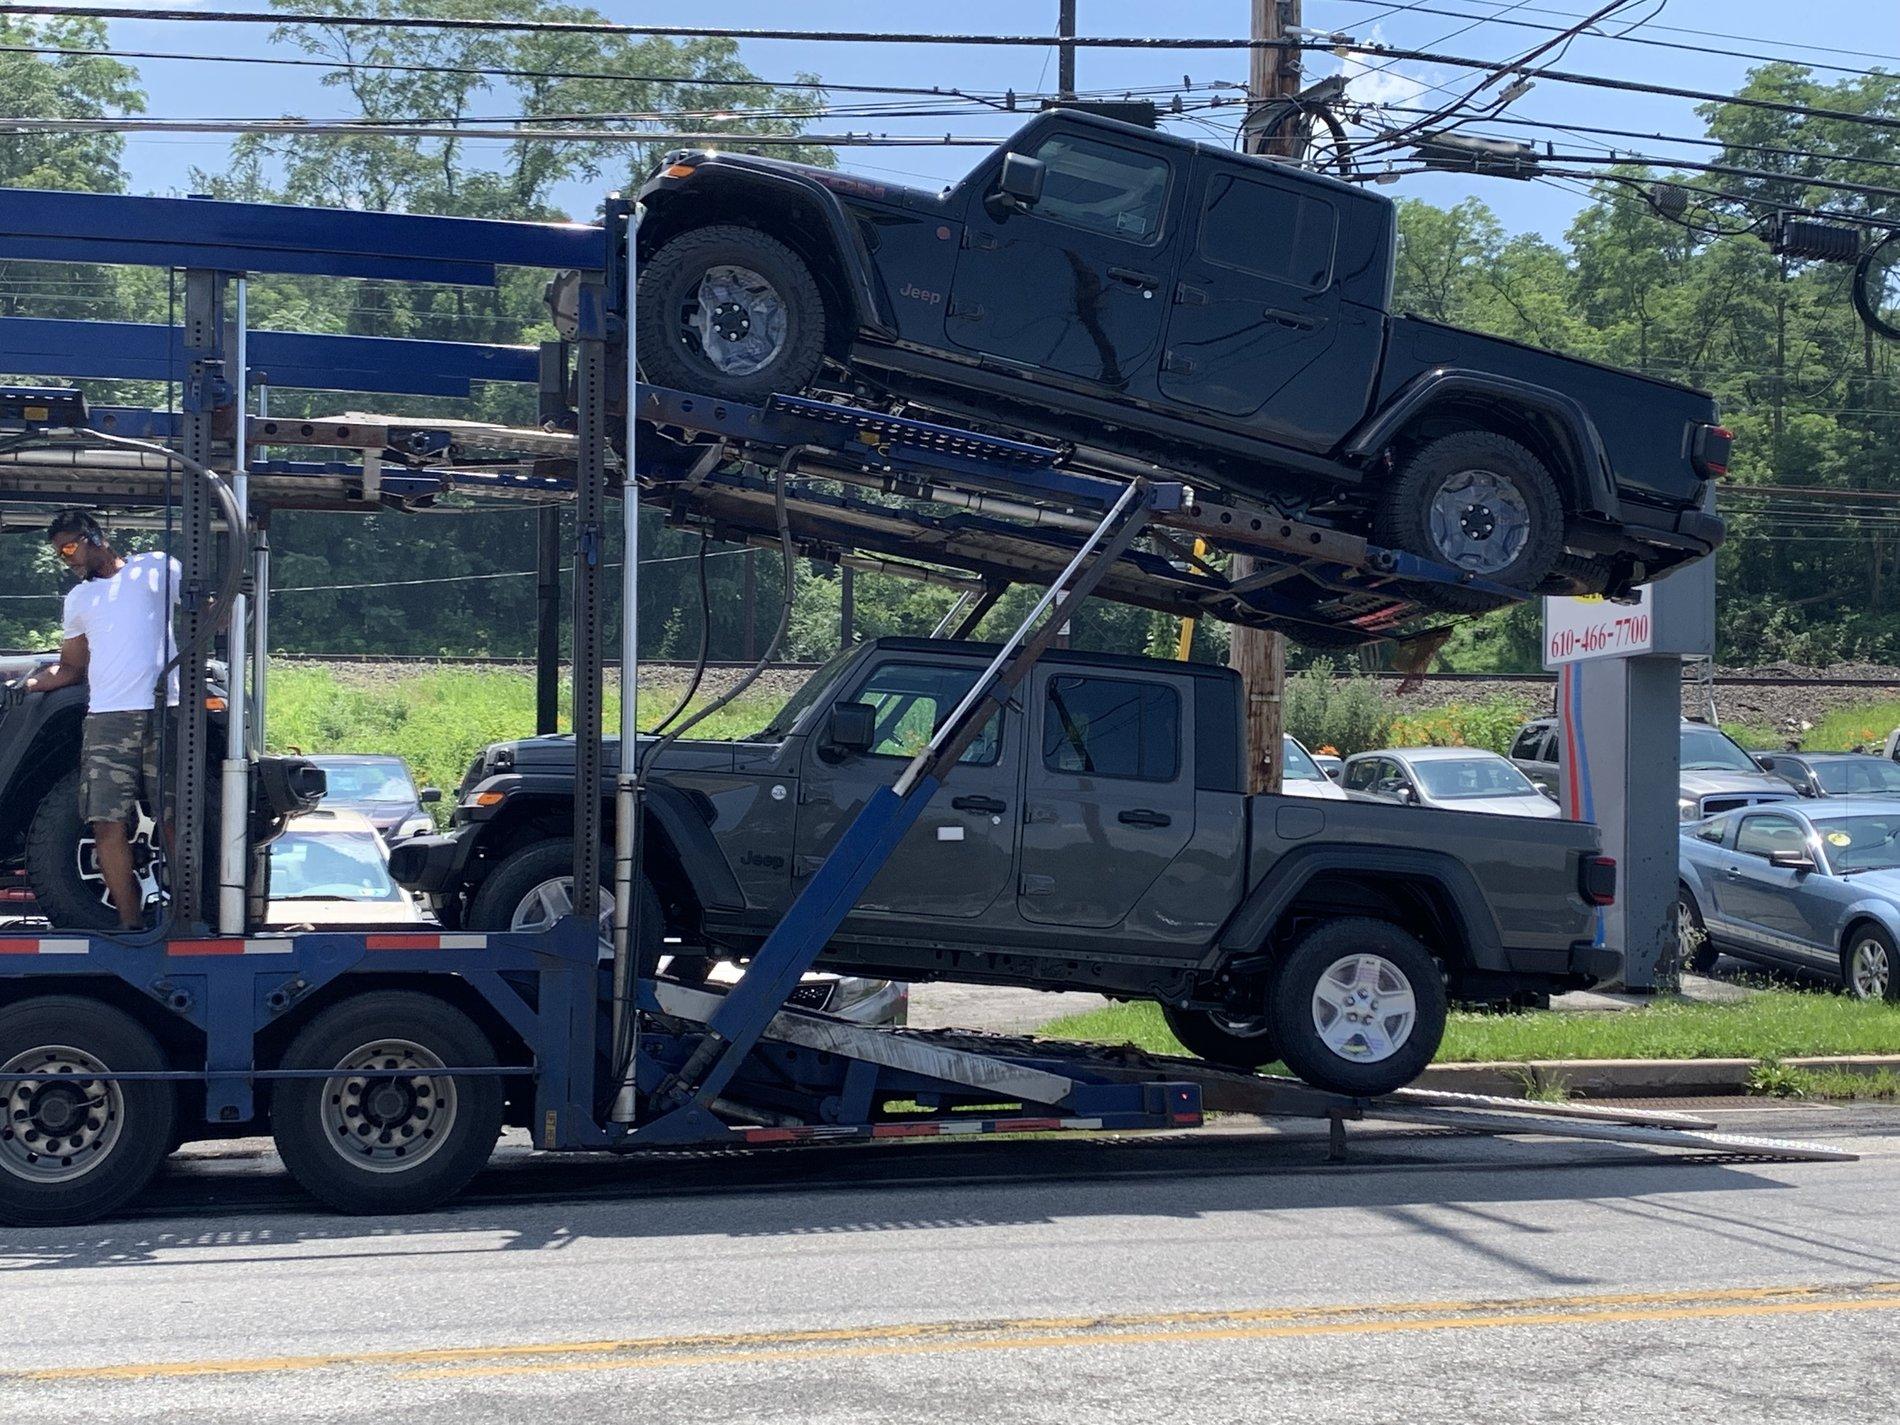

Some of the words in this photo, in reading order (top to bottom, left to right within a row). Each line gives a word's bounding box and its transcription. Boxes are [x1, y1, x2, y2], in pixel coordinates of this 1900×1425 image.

[900, 282, 942, 305] Jeep
[1551, 614, 1648, 658] 610-466-7700
[740, 850, 785, 870] Jeep
